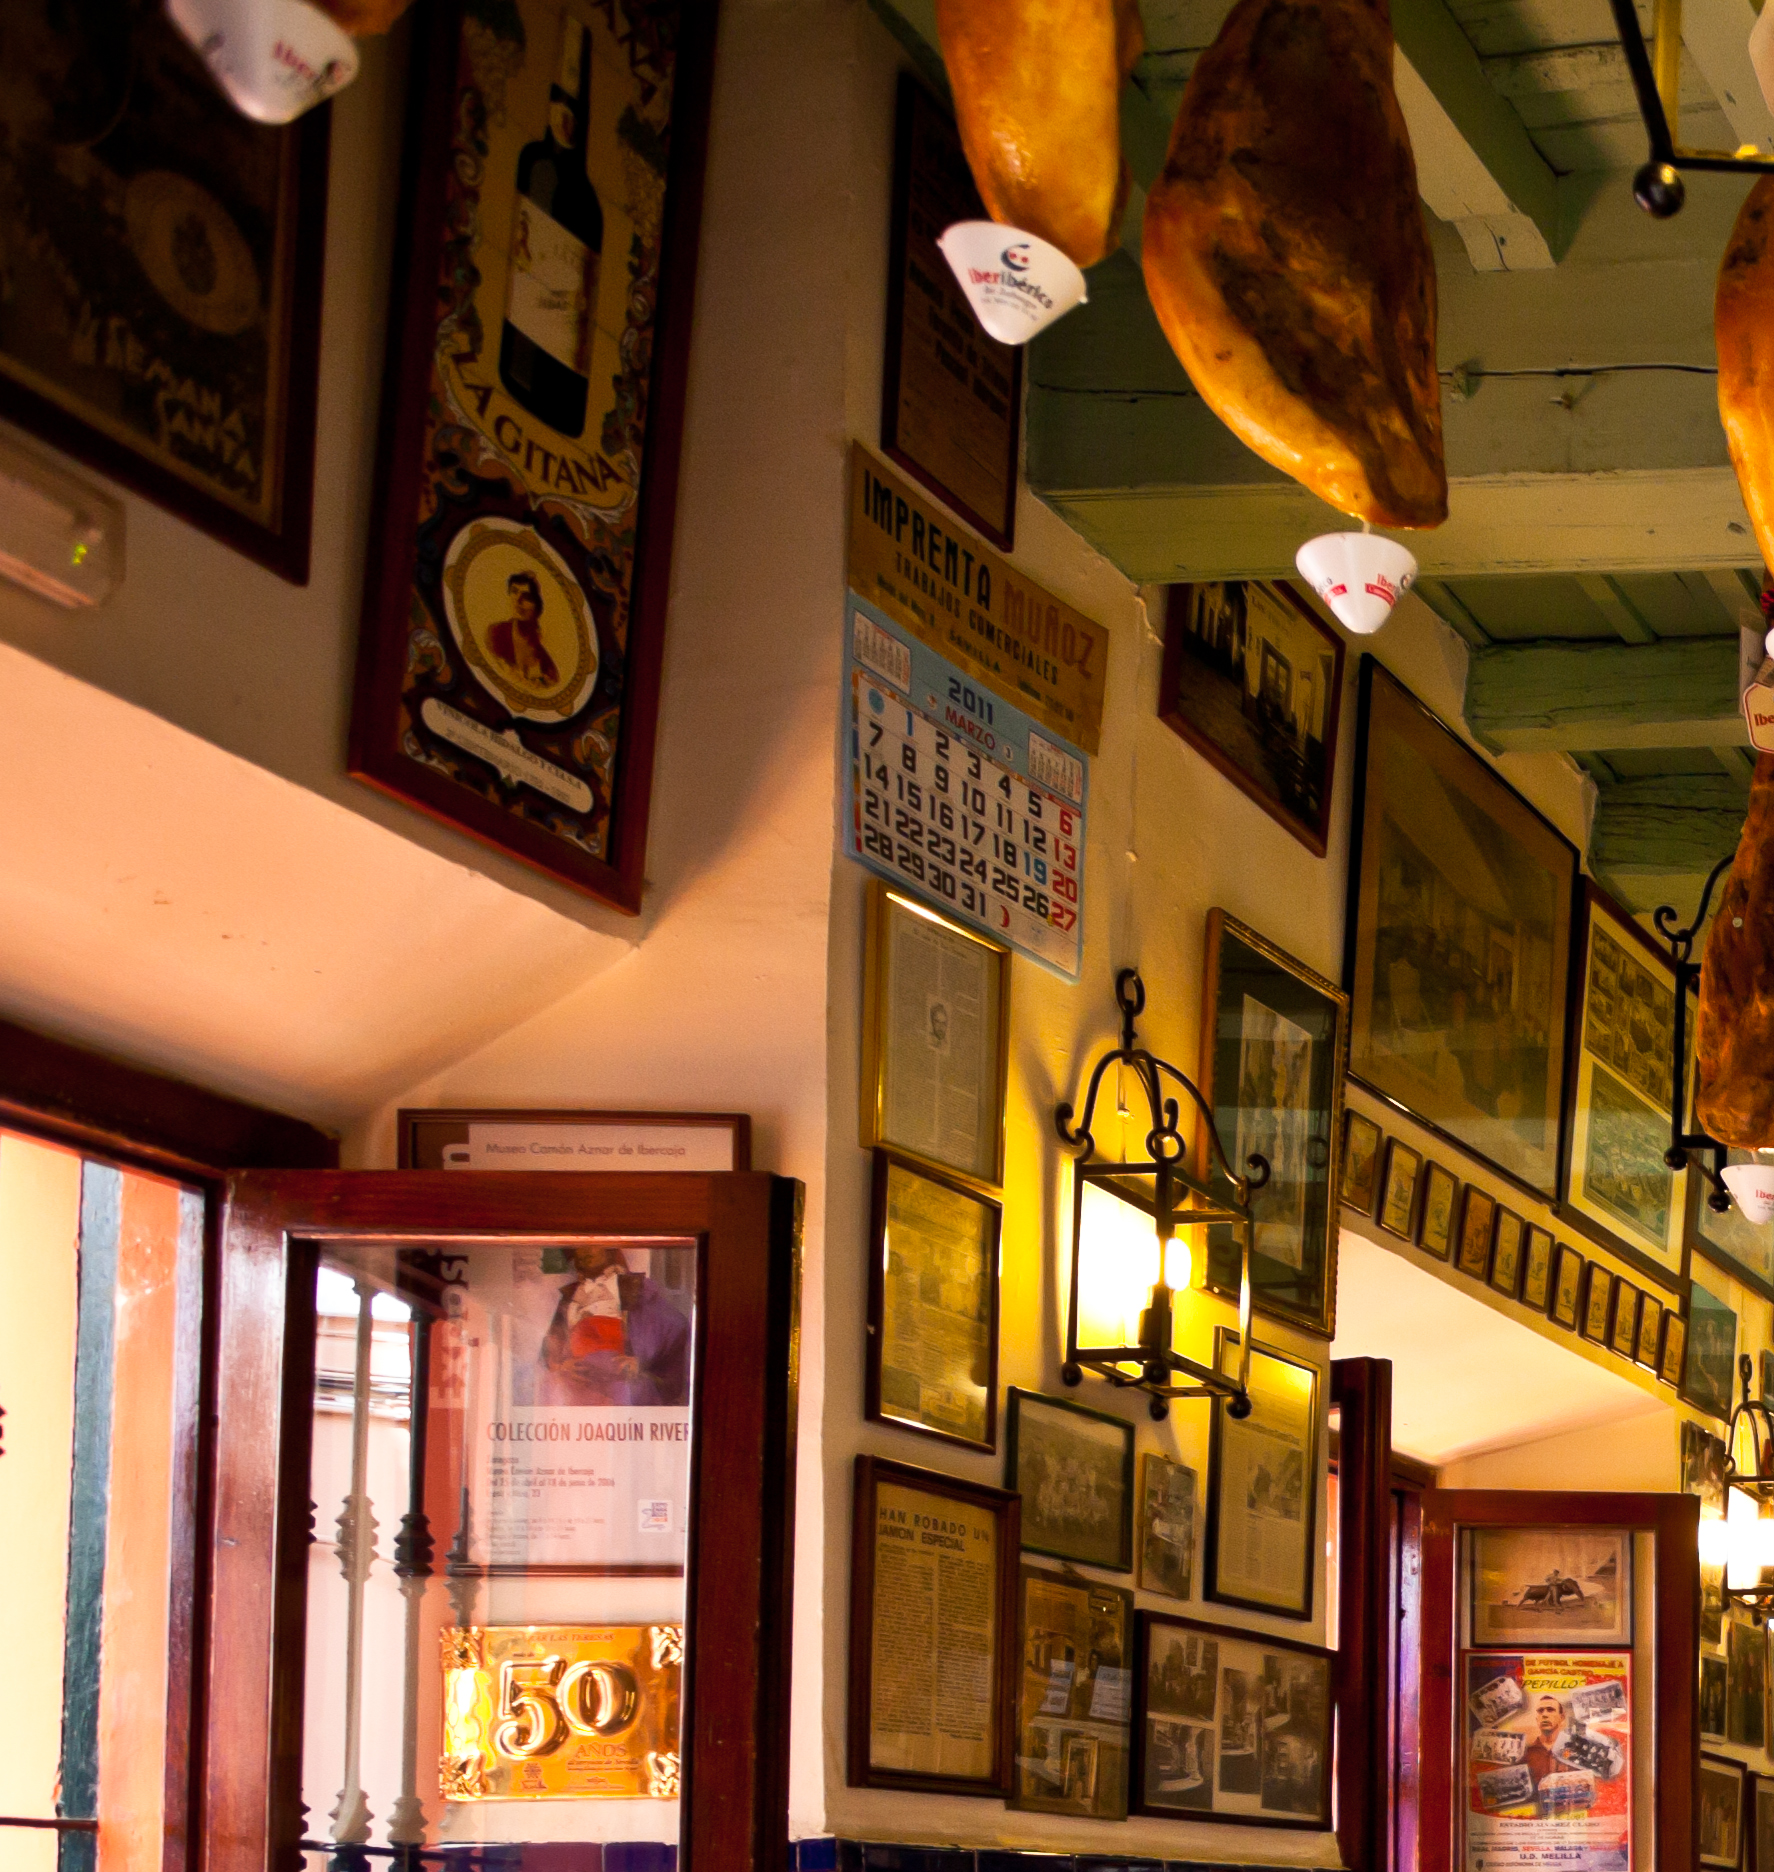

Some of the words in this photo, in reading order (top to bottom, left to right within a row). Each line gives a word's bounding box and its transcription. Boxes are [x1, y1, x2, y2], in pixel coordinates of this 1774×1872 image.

[451, 352, 494, 418] LA
[494, 415, 624, 494] GITANA
[864, 469, 992, 611] IMPRENTA
[1004, 580, 1095, 680] MUÑOZ
[968, 608, 1059, 687] COMERCIALES
[945, 706, 996, 750] MARZO
[949, 677, 994, 725] 2011
[869, 722, 883, 747] 7
[902, 744, 916, 773] 8
[935, 765, 949, 793] 9
[962, 780, 985, 816] 10
[997, 802, 1013, 834] 11
[1023, 818, 1047, 854] 12
[1054, 838, 1076, 871] 13
[906, 710, 914, 737] 1
[935, 730, 949, 760] 2
[967, 751, 981, 780] 3
[999, 774, 1011, 800] 4
[1028, 790, 1042, 818] 5
[1059, 809, 1073, 836] 6
[864, 752, 889, 790] 14
[897, 774, 921, 812] 15
[929, 794, 954, 831] 16
[962, 814, 985, 845] 17
[993, 833, 1017, 868] 18
[1024, 851, 1048, 885] 19
[1052, 869, 1078, 903] 20
[864, 788, 890, 827] 21
[895, 809, 923, 847] 22
[927, 829, 956, 866] 23
[959, 848, 987, 884] 24
[992, 867, 1020, 903] 25
[1023, 884, 1049, 919] 26
[1050, 901, 1077, 932] 27
[864, 823, 894, 862] 28
[897, 843, 925, 881] 29
[928, 863, 956, 900] 30
[961, 882, 986, 917] 31
[485, 1143, 527, 1155] Museo
[618, 1144, 634, 1155] de
[487, 1418, 570, 1442] COLECCIÓN
[576, 1417, 643, 1442] JOAQUÍN
[879, 1507, 907, 1525] HAN
[913, 1513, 967, 1537] ROBADO
[495, 1655, 640, 1761] 50
